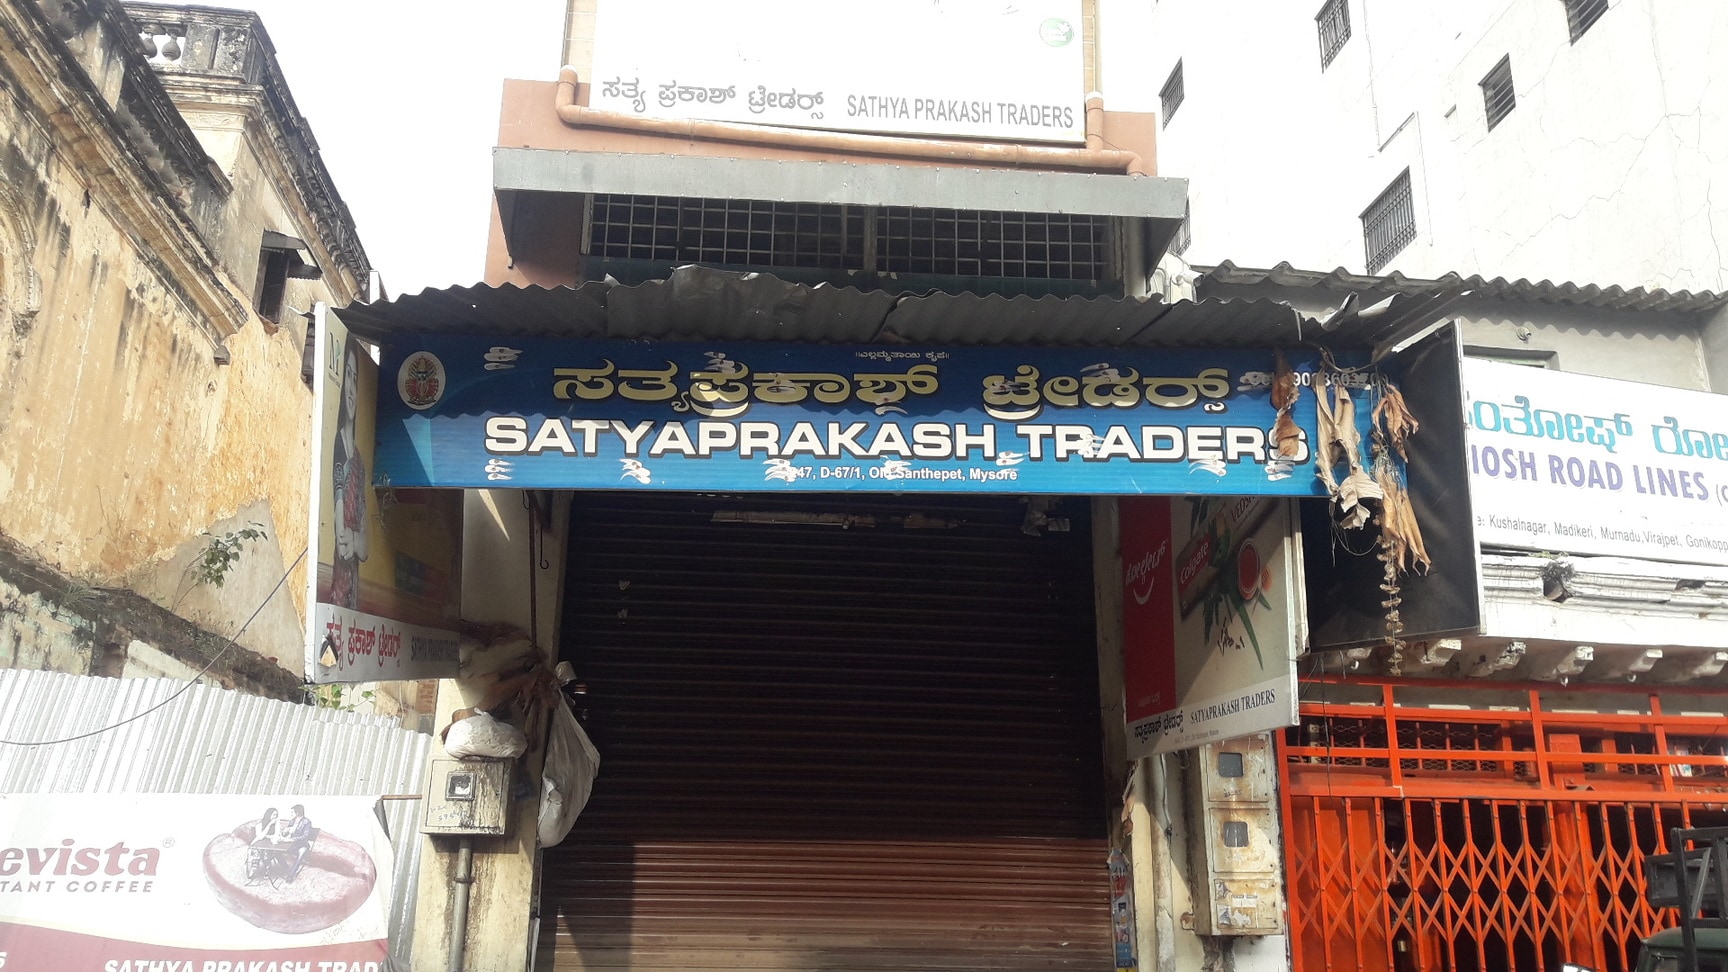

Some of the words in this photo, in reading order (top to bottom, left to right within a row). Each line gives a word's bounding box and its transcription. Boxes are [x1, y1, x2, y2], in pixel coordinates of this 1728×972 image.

[602, 76, 647, 113] ಸತ್ಯ
[658, 80, 736, 108] ಪ್ರಕಾಶ್
[748, 85, 825, 119] ಟ್ರೇಡರ್ಸ್
[847, 94, 910, 119] SATHYA
[914, 98, 992, 123] PRAKASH
[997, 102, 1074, 128] TRADERS
[982, 364, 1231, 421] ಟ್ರೇಡರ್ಸ್
[485, 416, 997, 460] SATYAPRAKASH
[820, 466, 866, 480] D-67/1,
[969, 468, 1018, 482] Mysore
[1548, 455, 1624, 491] ROAD
[1633, 465, 1709, 501] LINES
[1489, 514, 1551, 535] Kushalnagar,
[1554, 521, 1597, 540] Madikeri,
[1180, 541, 1209, 585] Colgate
[1190, 699, 1240, 725] SATYAPRAKASH
[1241, 688, 1276, 711] TRADERS
[66, 880, 153, 893] COFFEE
[315, 959, 383, 972] TRAD
